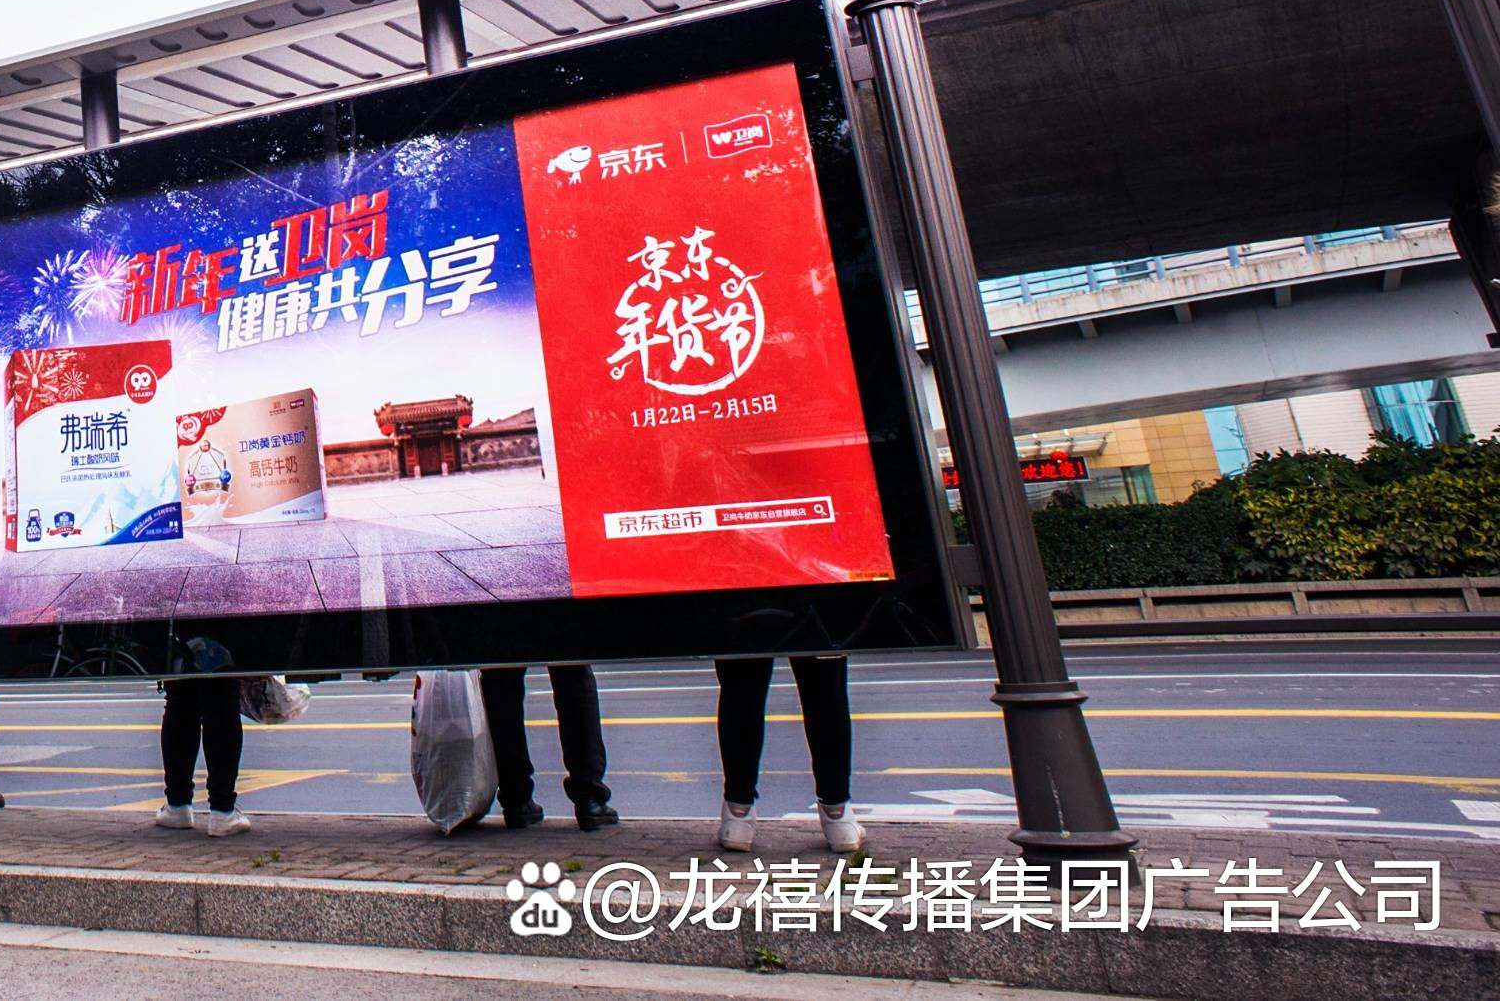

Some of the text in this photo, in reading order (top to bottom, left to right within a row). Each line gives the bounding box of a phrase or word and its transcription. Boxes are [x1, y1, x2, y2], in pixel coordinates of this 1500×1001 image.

[597, 142, 667, 179] 京东
[118, 189, 389, 325] 新年送卫岗
[627, 226, 717, 291] 京东
[216, 234, 499, 353] 健康共分享
[606, 293, 757, 385] 年货节
[630, 394, 778, 428] 1月22日-2月15日
[60, 411, 129, 453] 弗瑞希
[239, 430, 306, 453] 卫岗黄金钙奶
[250, 455, 298, 478] 高钙牛奶
[618, 511, 702, 534] 京东超市
